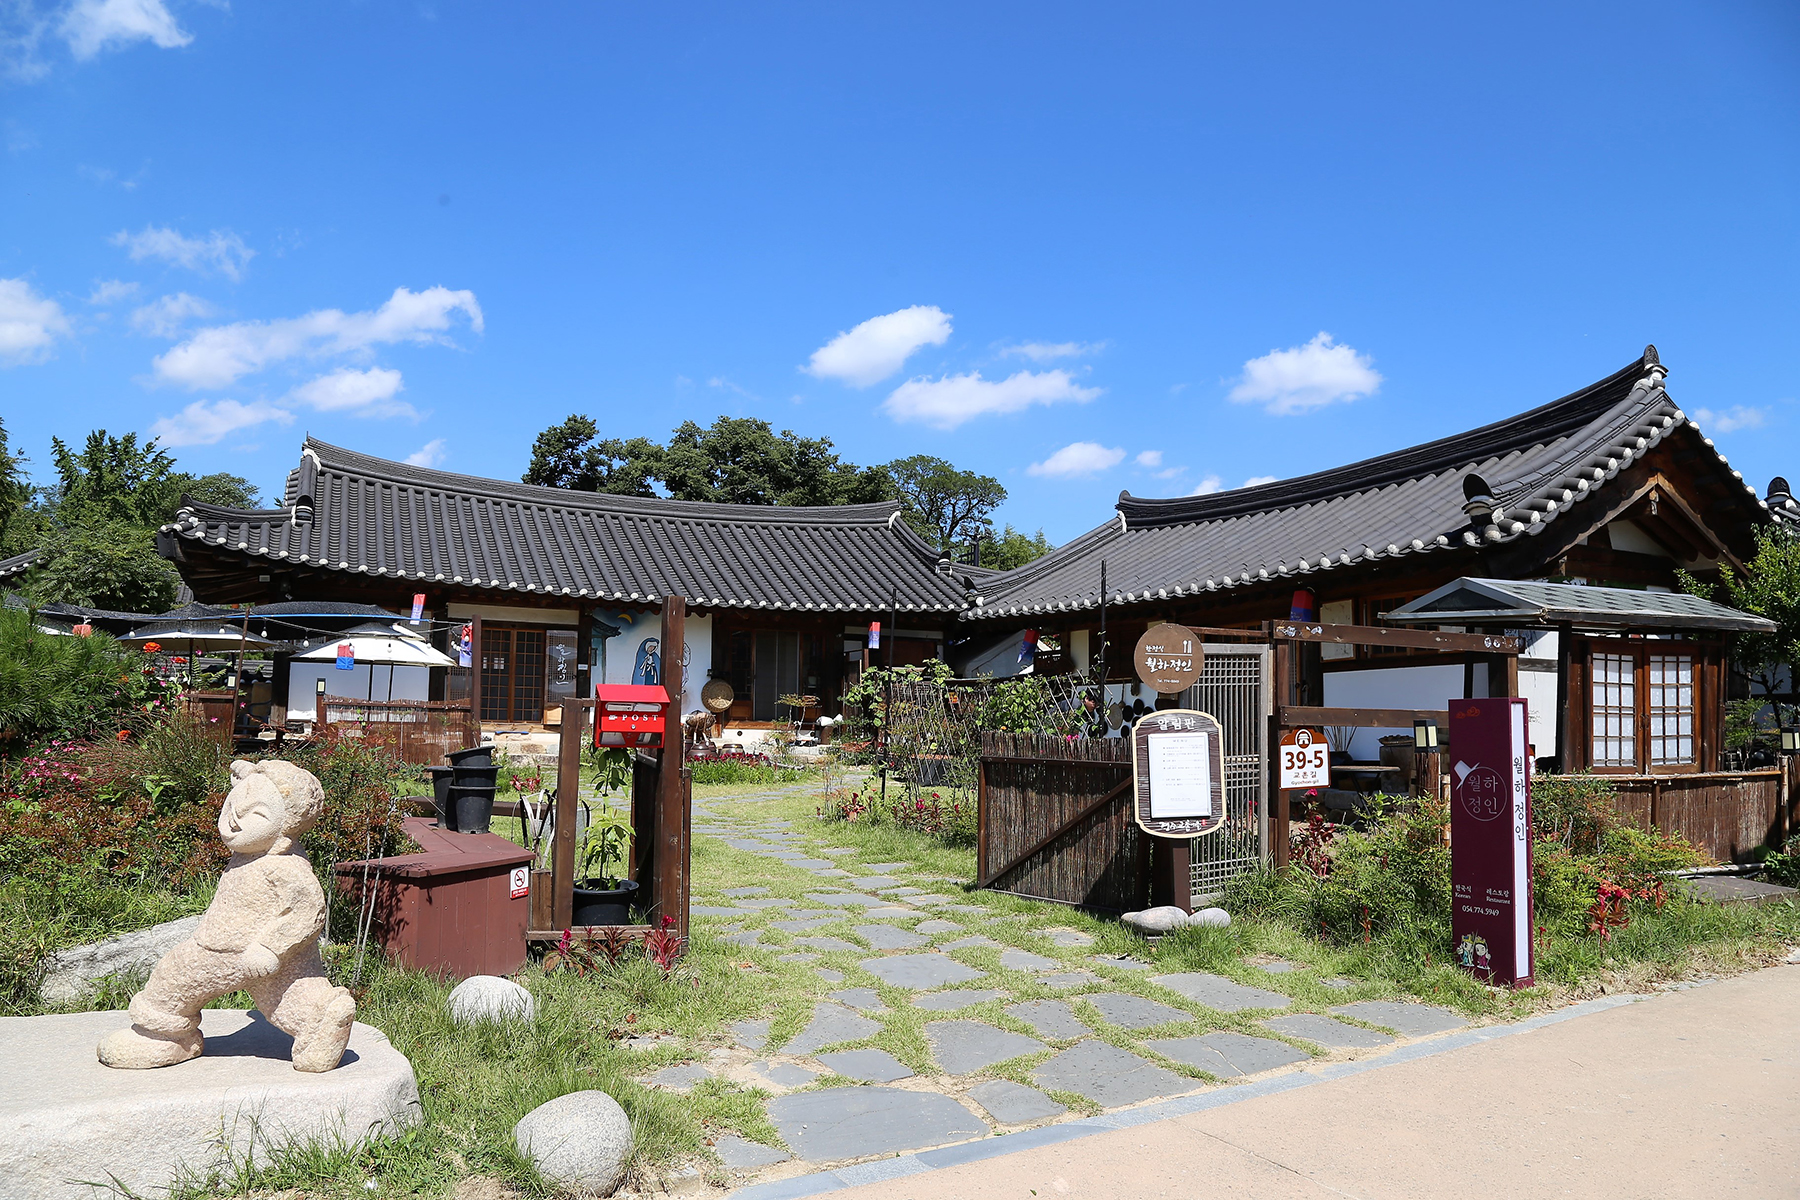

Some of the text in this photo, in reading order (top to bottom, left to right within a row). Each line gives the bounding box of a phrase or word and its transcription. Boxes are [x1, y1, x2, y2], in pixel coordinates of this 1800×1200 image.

[1145, 656, 1193, 673] 월하정인
[621, 714, 659, 722] POST
[1158, 717, 1196, 731] 알림판
[1285, 750, 1324, 770] 39-5
[1293, 771, 1317, 779] 교촌길
[1468, 775, 1498, 793] 월하
[1468, 796, 1498, 815] 정인
[1513, 756, 1525, 841] 월하정인
[1486, 888, 1510, 898] 레스토랑
[1461, 905, 1500, 916] 054.774.5949
